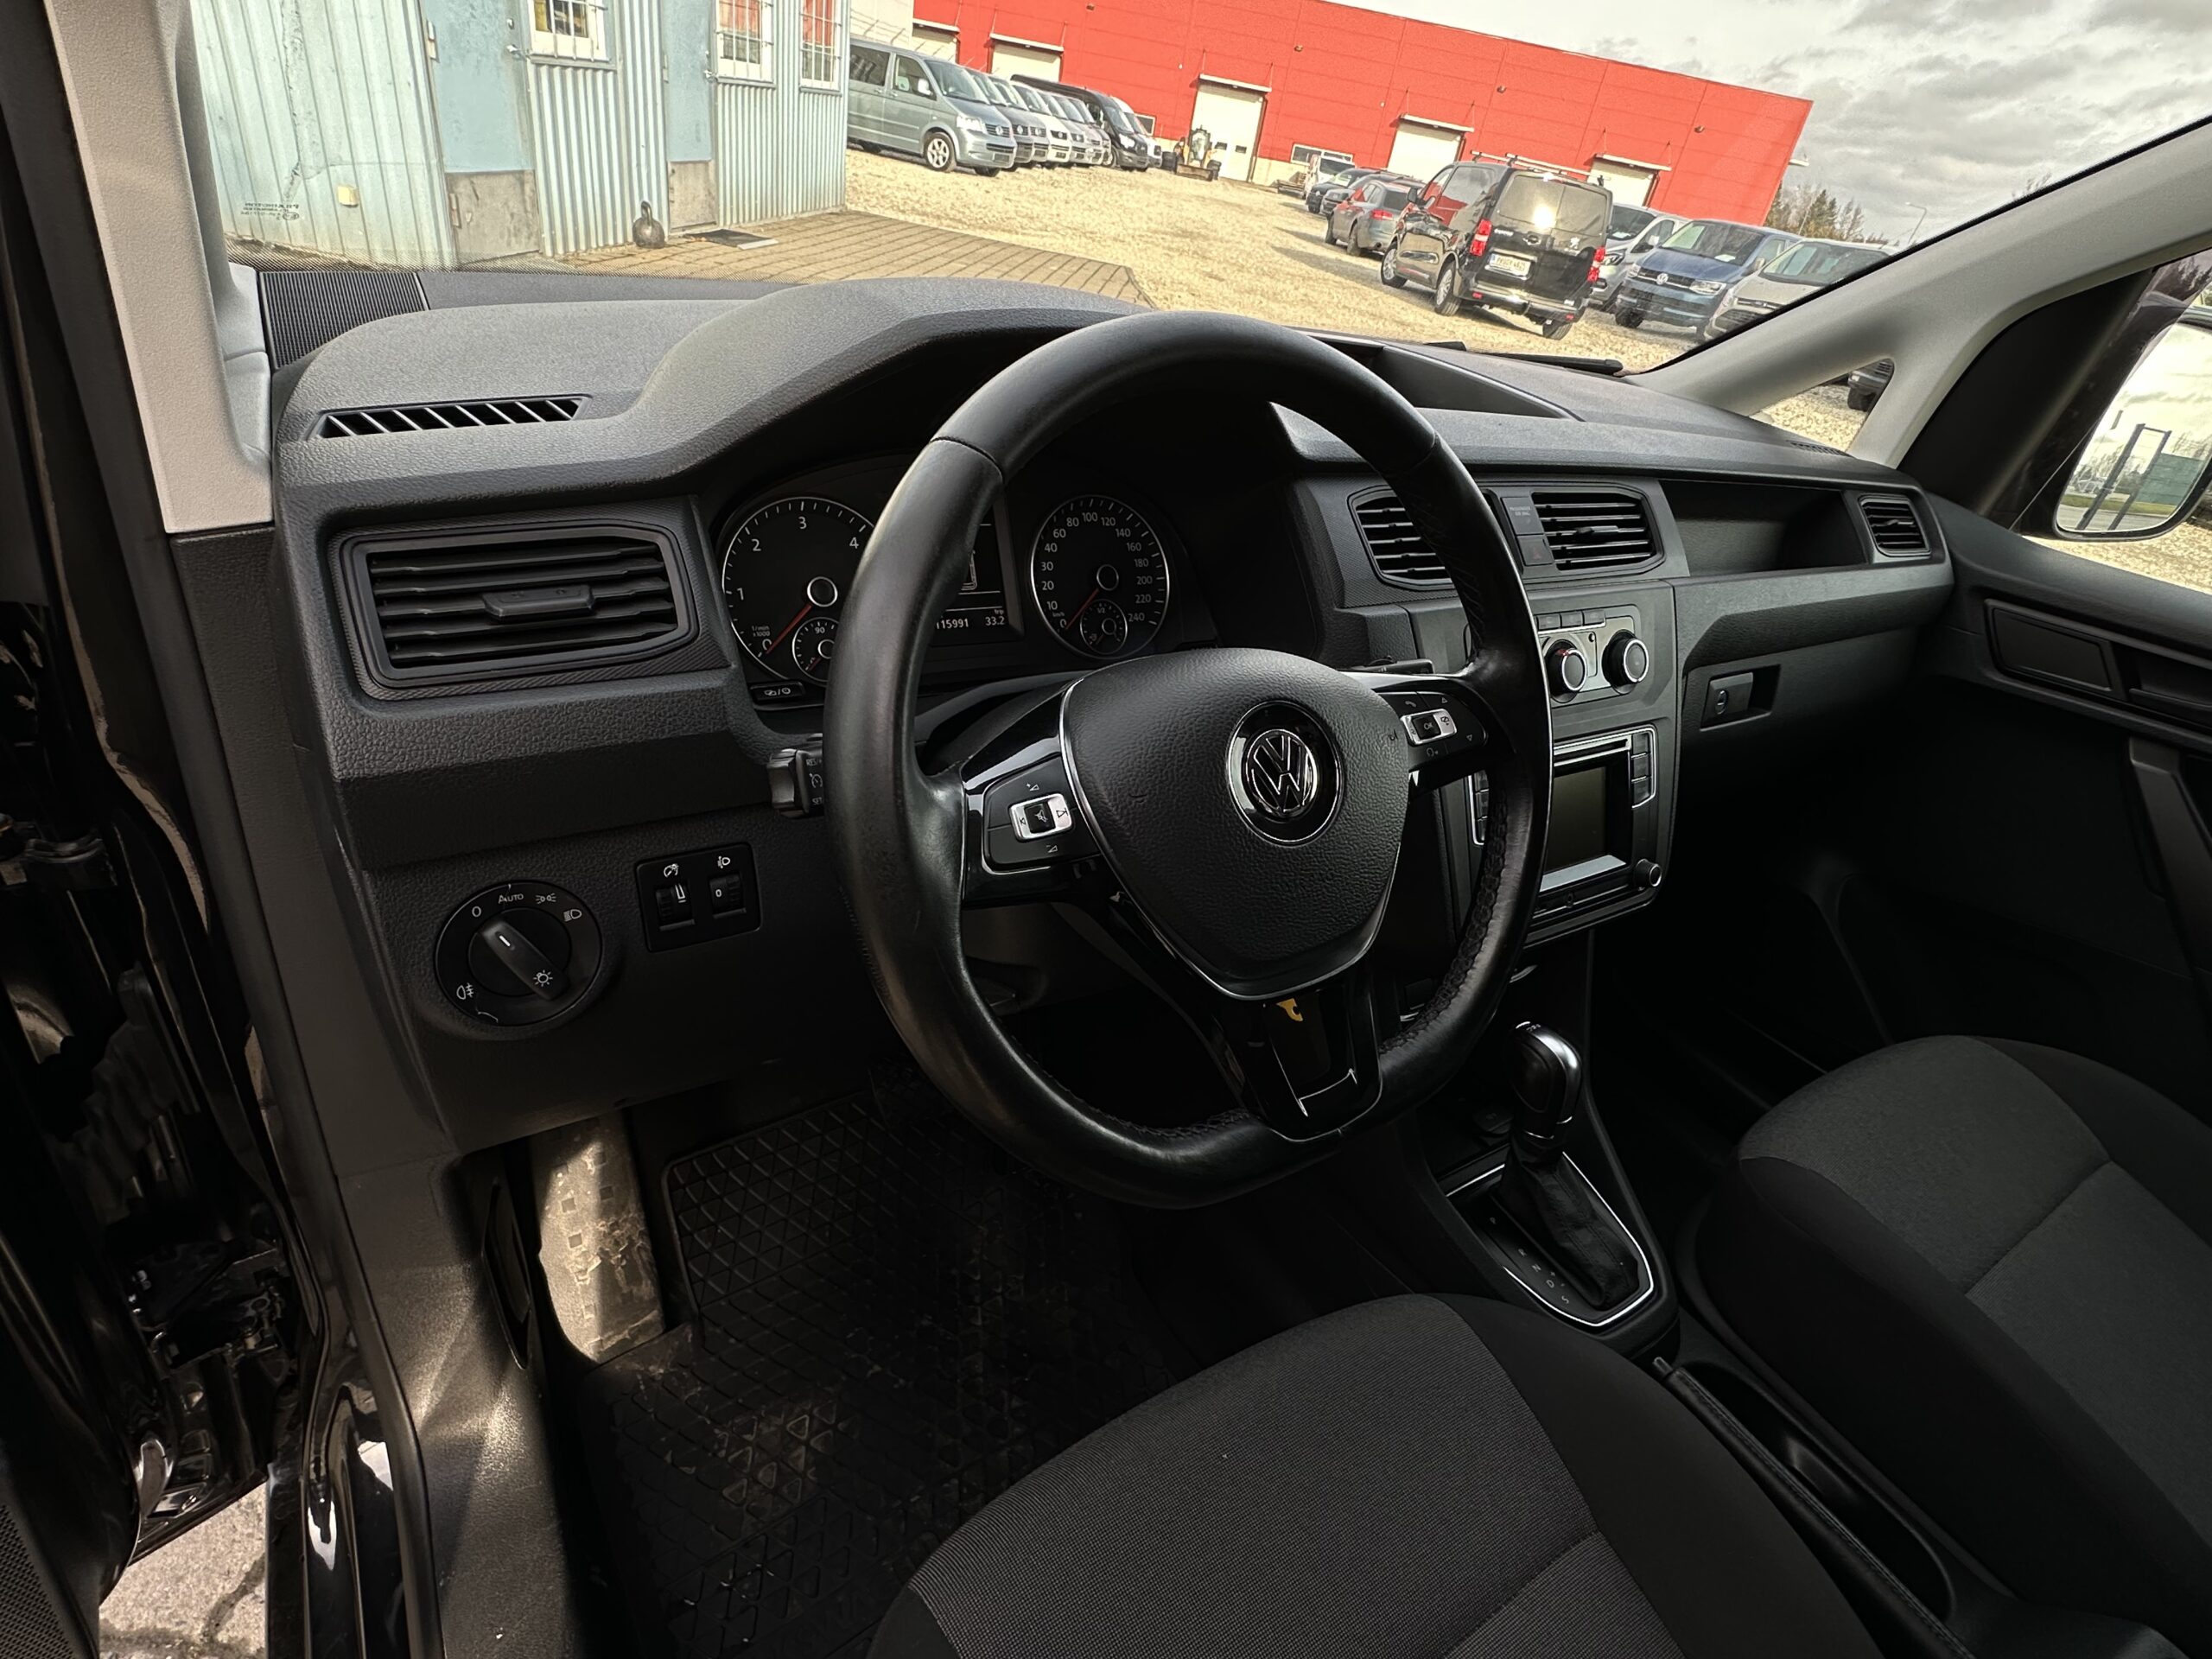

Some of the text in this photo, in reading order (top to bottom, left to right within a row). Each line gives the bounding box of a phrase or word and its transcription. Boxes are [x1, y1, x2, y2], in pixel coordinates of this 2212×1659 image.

[1066, 517, 1080, 528] 80
[1082, 512, 1098, 523] 100
[1102, 517, 1116, 527] 120
[798, 516, 808, 530] 3
[1052, 528, 1067, 538] 60
[1116, 528, 1131, 538] 140
[751, 538, 762, 552] 2
[849, 537, 859, 550] 4
[1044, 543, 1058, 553] 40
[1126, 542, 1141, 552] 160
[1041, 561, 1054, 571] 30
[1134, 557, 1149, 568] 180
[1136, 575, 1153, 586] 200
[1041, 581, 1055, 591] 20
[736, 588, 744, 601] 1
[1135, 594, 1152, 604] 220
[1047, 601, 1058, 612] 10
[985, 615, 1005, 626] 33.2
[1128, 613, 1145, 623] 240
[814, 626, 826, 635] 90
